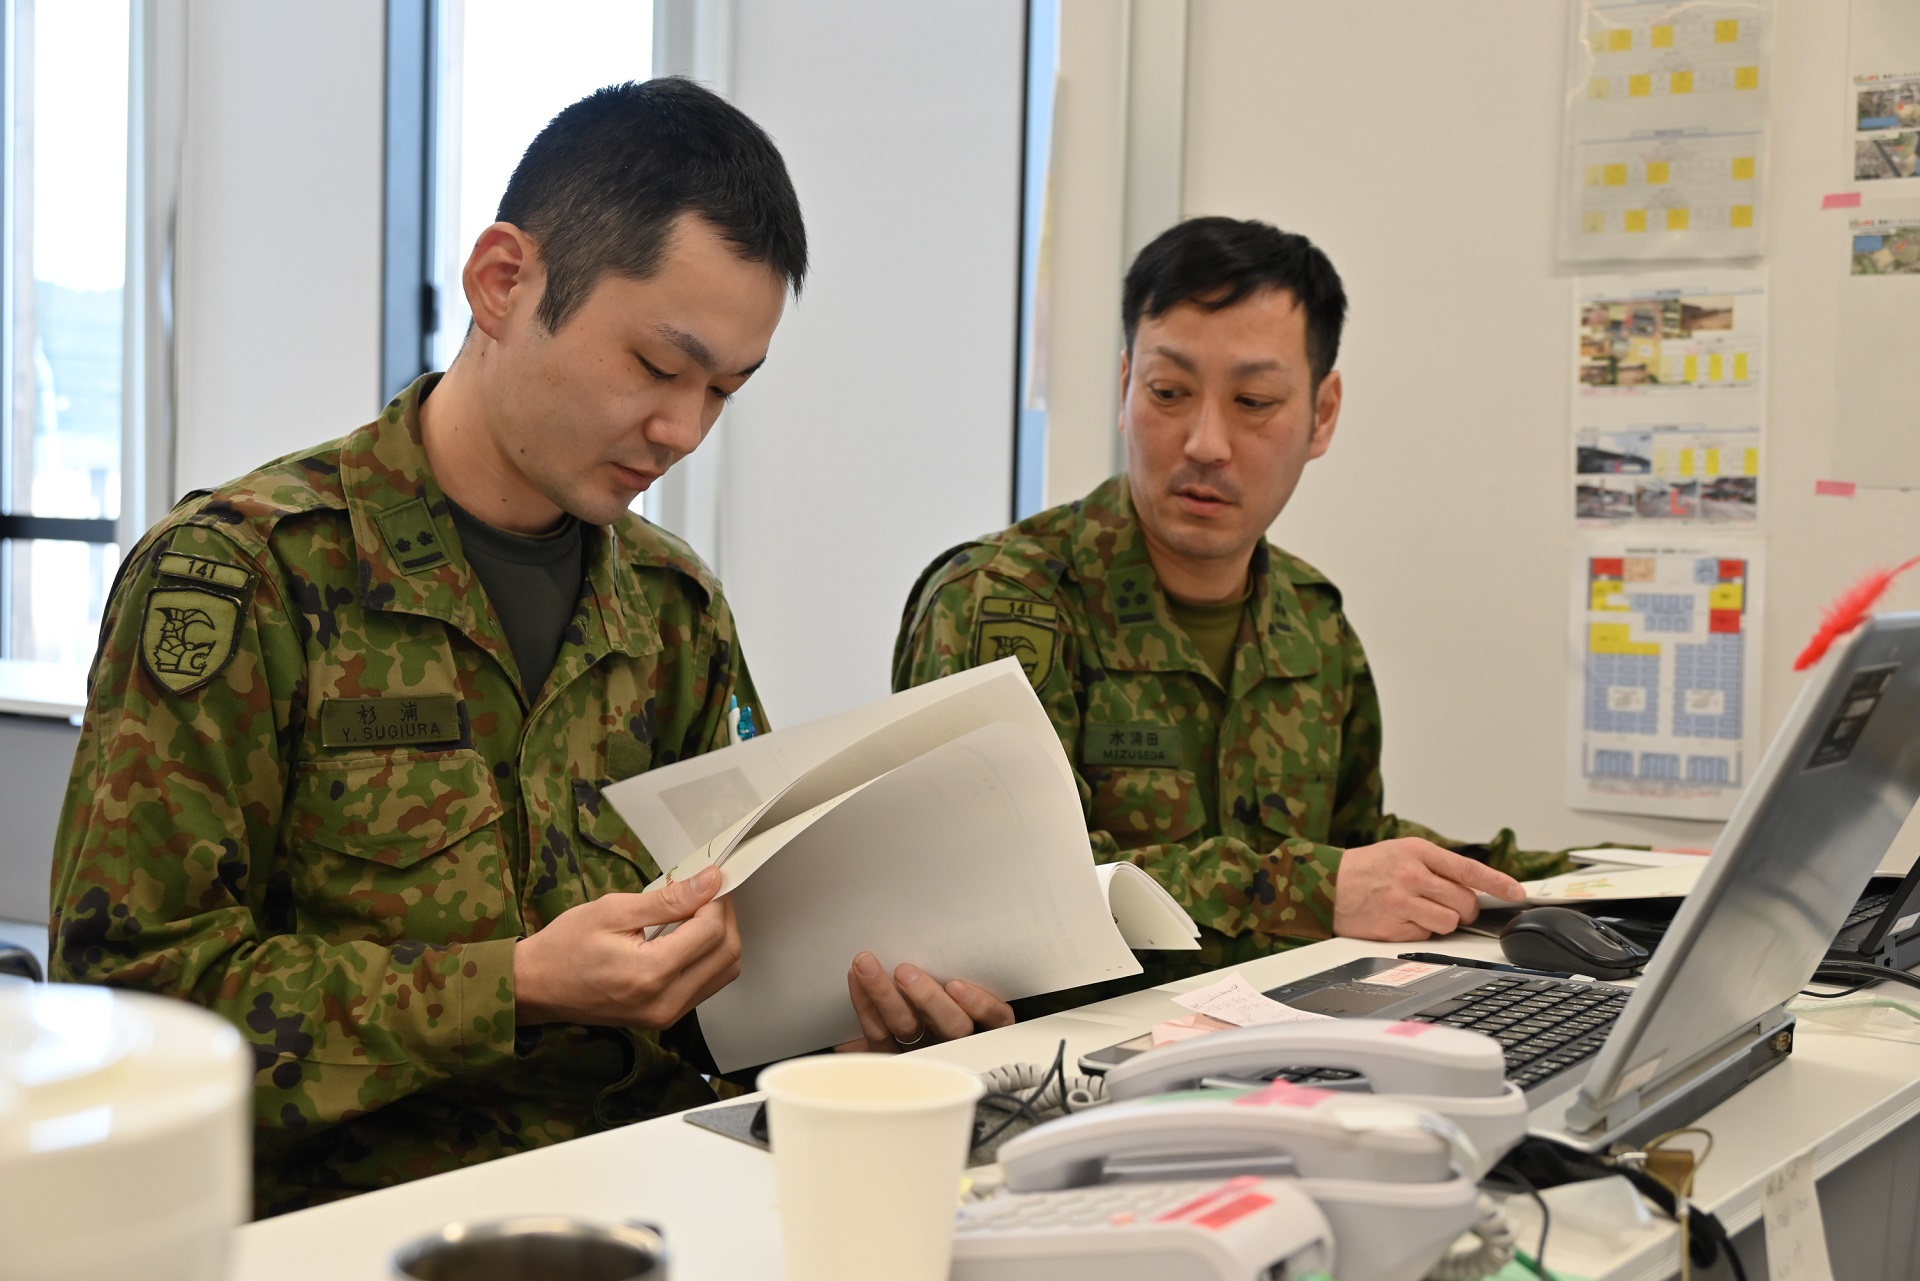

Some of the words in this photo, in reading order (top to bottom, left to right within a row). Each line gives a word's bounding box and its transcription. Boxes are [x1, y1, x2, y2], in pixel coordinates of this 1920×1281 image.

[187, 559, 217, 580] 141
[1009, 601, 1033, 615] 141
[356, 701, 418, 725] 杉浦
[1103, 749, 1165, 760] MIZUSEDA
